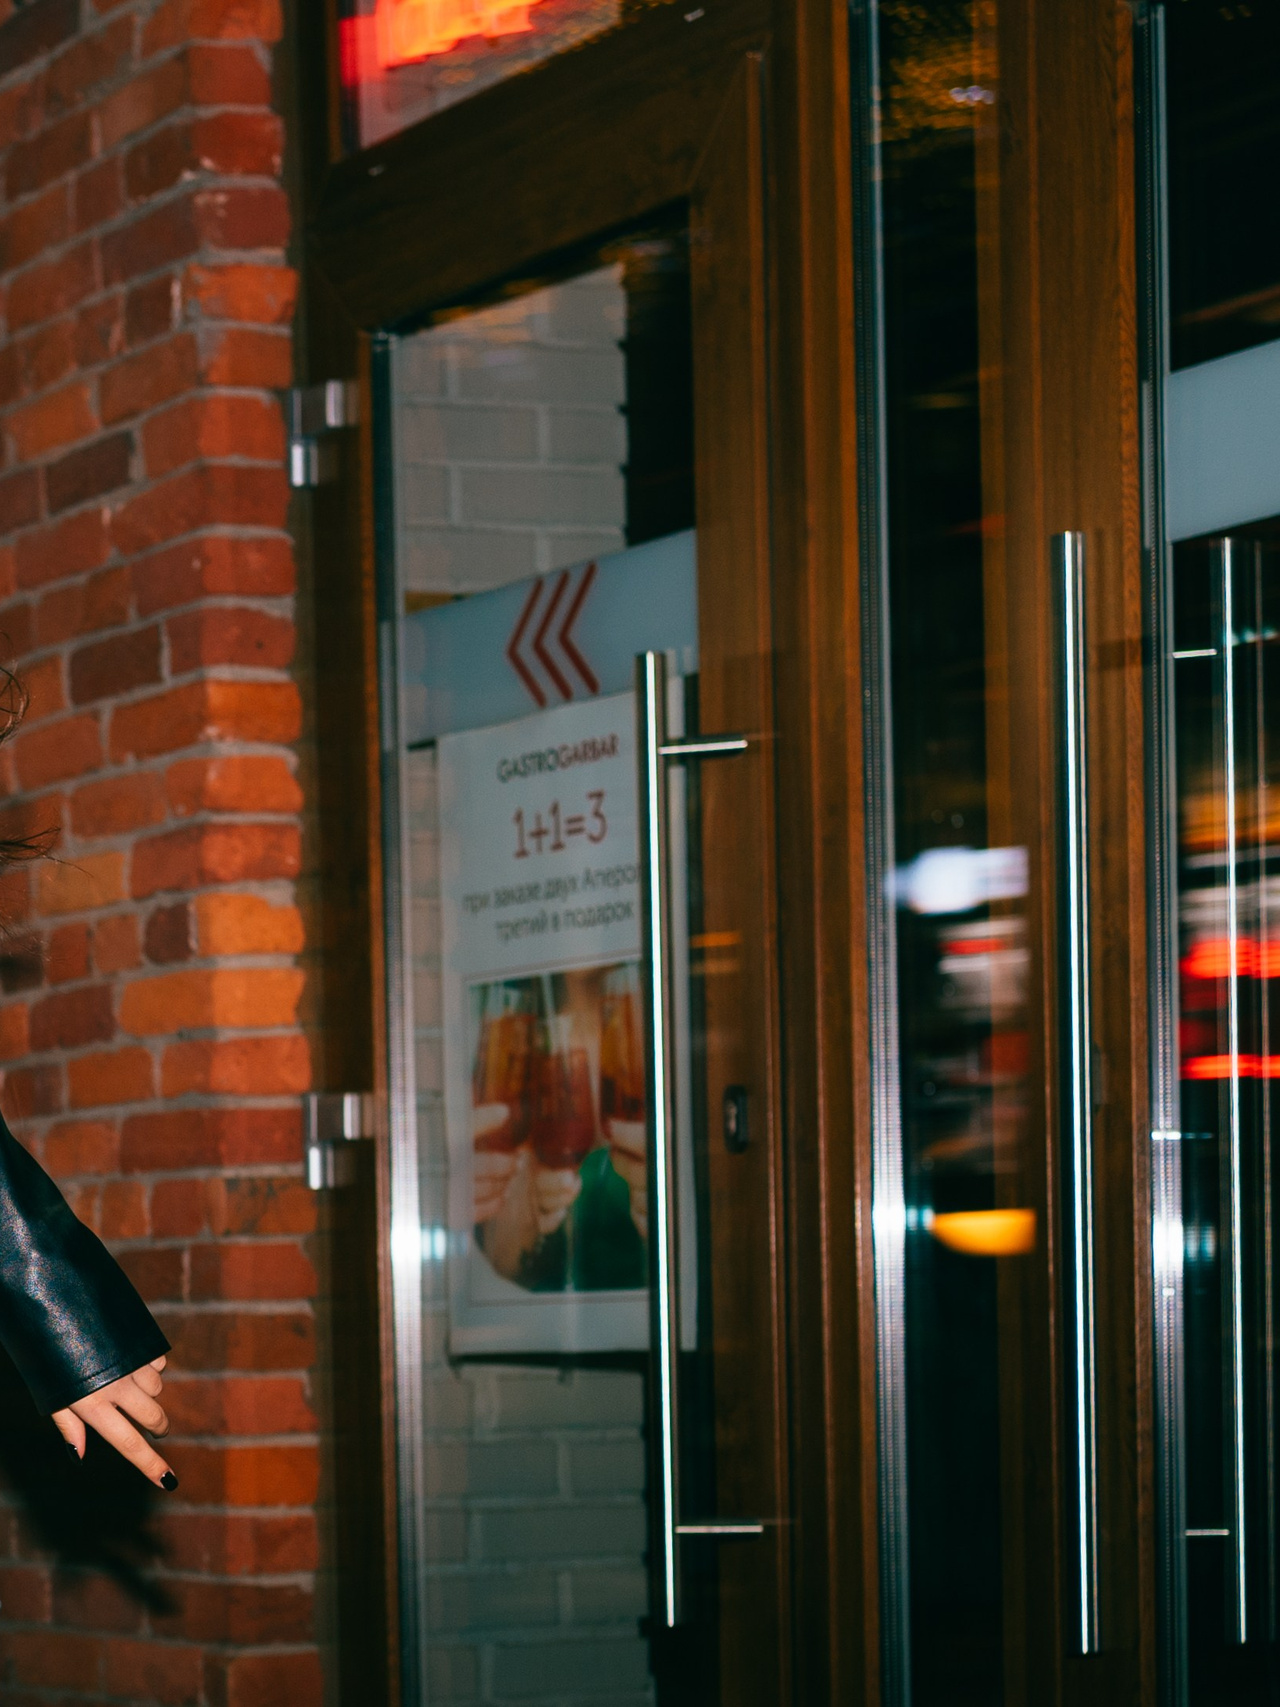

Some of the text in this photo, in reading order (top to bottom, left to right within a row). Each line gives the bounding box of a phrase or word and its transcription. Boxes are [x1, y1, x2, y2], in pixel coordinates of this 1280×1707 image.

[512, 788, 609, 859] 1+1=3
[582, 862, 640, 891] Аперо
[496, 909, 549, 942] третий
[563, 900, 634, 930] подарок
